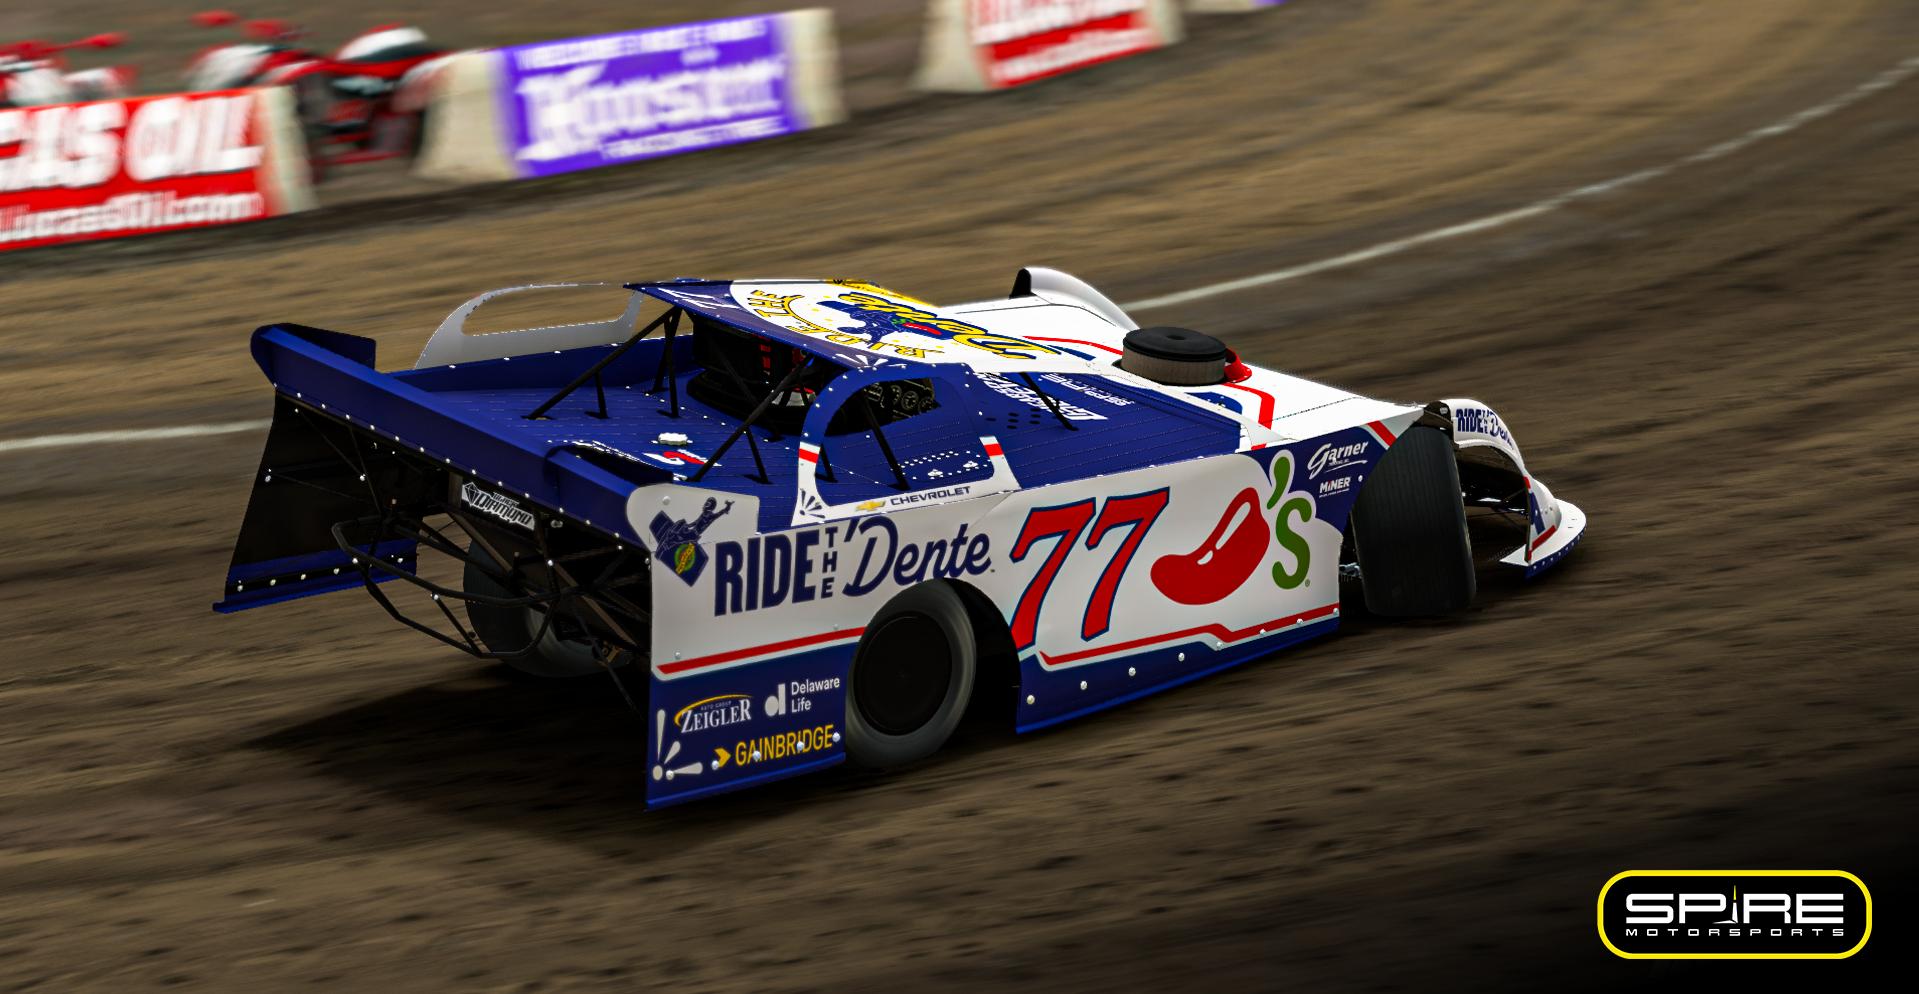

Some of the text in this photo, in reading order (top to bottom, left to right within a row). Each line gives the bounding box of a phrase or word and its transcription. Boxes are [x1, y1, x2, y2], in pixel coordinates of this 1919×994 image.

[125, 97, 264, 183] OIL
[1307, 441, 1369, 480] Garner
[890, 486, 971, 506] CHEVROLET
[714, 528, 820, 617] RIDE
[820, 526, 838, 599] THE
[1009, 486, 1170, 651] 77
[791, 677, 840, 695] Delaware
[791, 698, 812, 713] Life
[681, 698, 752, 734] ZEIGLER
[735, 724, 834, 766] GAINBRIDGE
